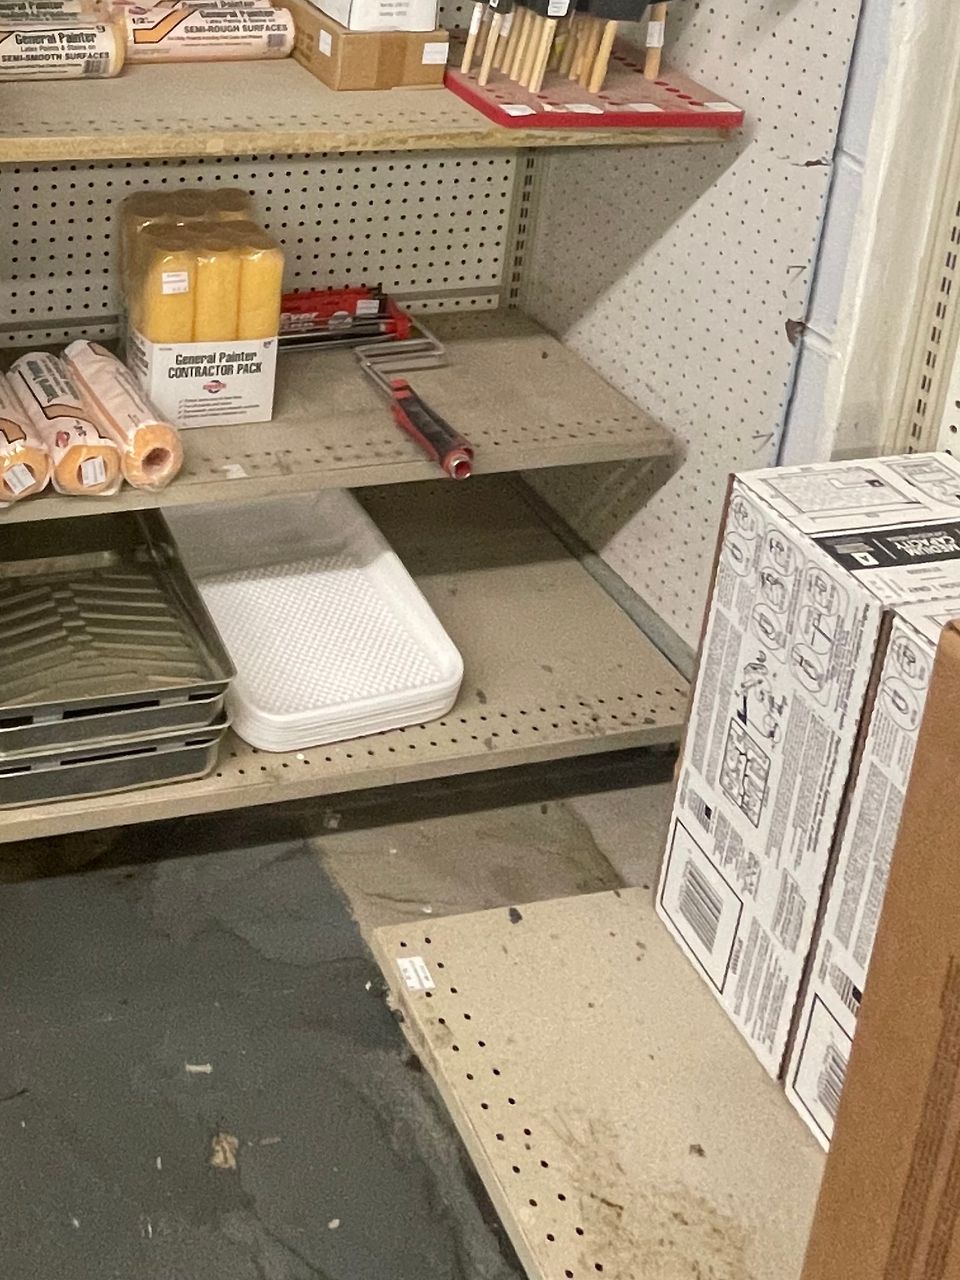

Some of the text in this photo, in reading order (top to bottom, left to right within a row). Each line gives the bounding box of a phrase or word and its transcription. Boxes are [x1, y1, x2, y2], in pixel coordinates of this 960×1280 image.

[184, 24, 288, 34] SEMI-ROUGH SURFACES
[15, 31, 97, 45] General Painter
[2, 52, 110, 62] SEMI-SMOOTH SURFACES
[175, 351, 257, 365] General Painter
[168, 361, 263, 379] CONTRACTOR PACK
